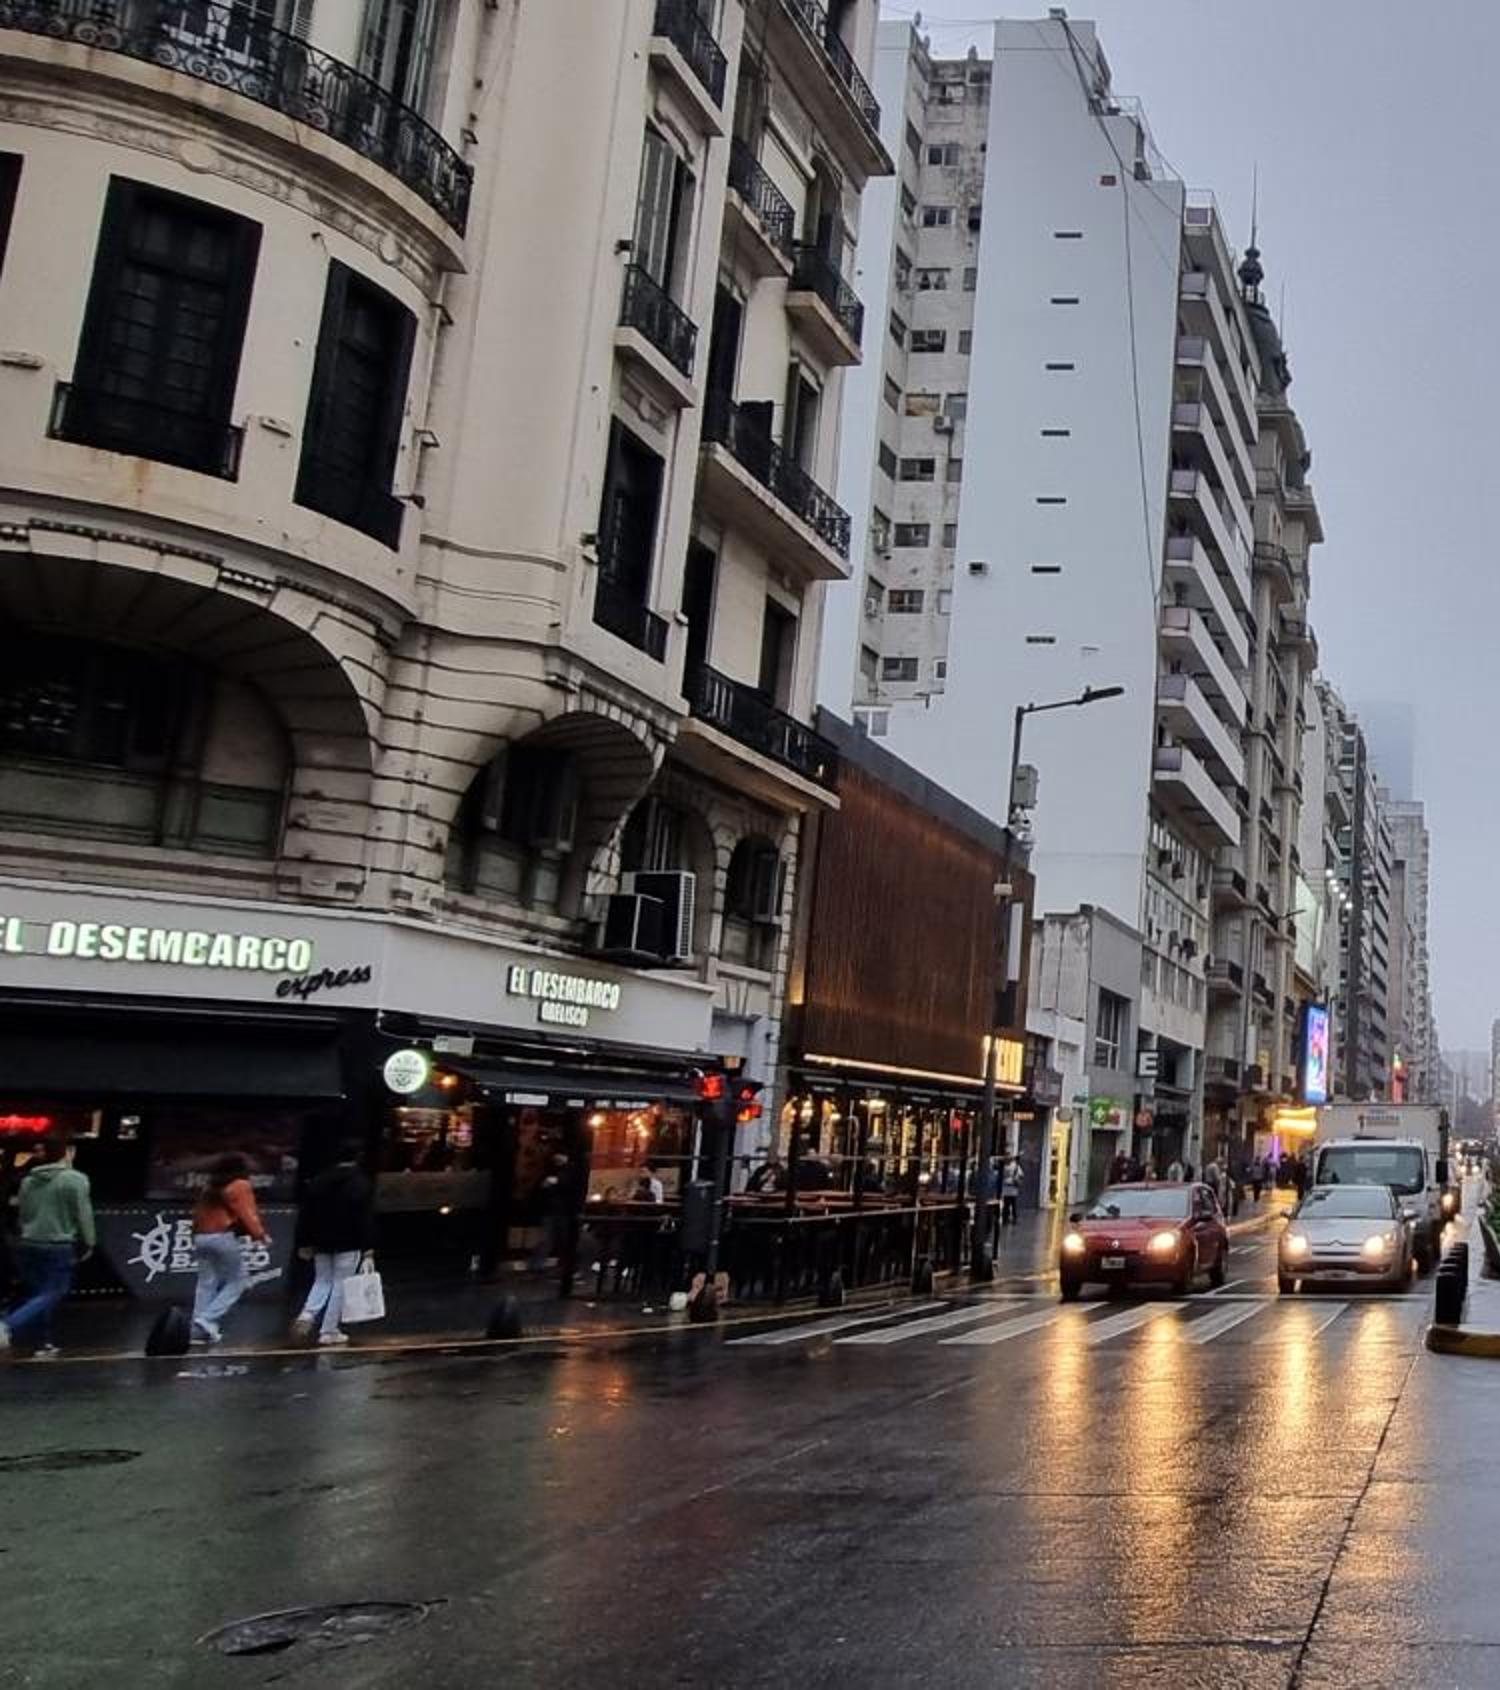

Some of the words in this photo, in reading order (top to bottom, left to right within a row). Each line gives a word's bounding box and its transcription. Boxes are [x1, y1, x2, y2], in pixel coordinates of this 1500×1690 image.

[47, 920, 313, 972] DESEMBARCO
[276, 963, 372, 1000] express
[510, 965, 529, 995] EL
[531, 969, 620, 1010] DESEMBARCO
[1139, 1052, 1159, 1076] E
